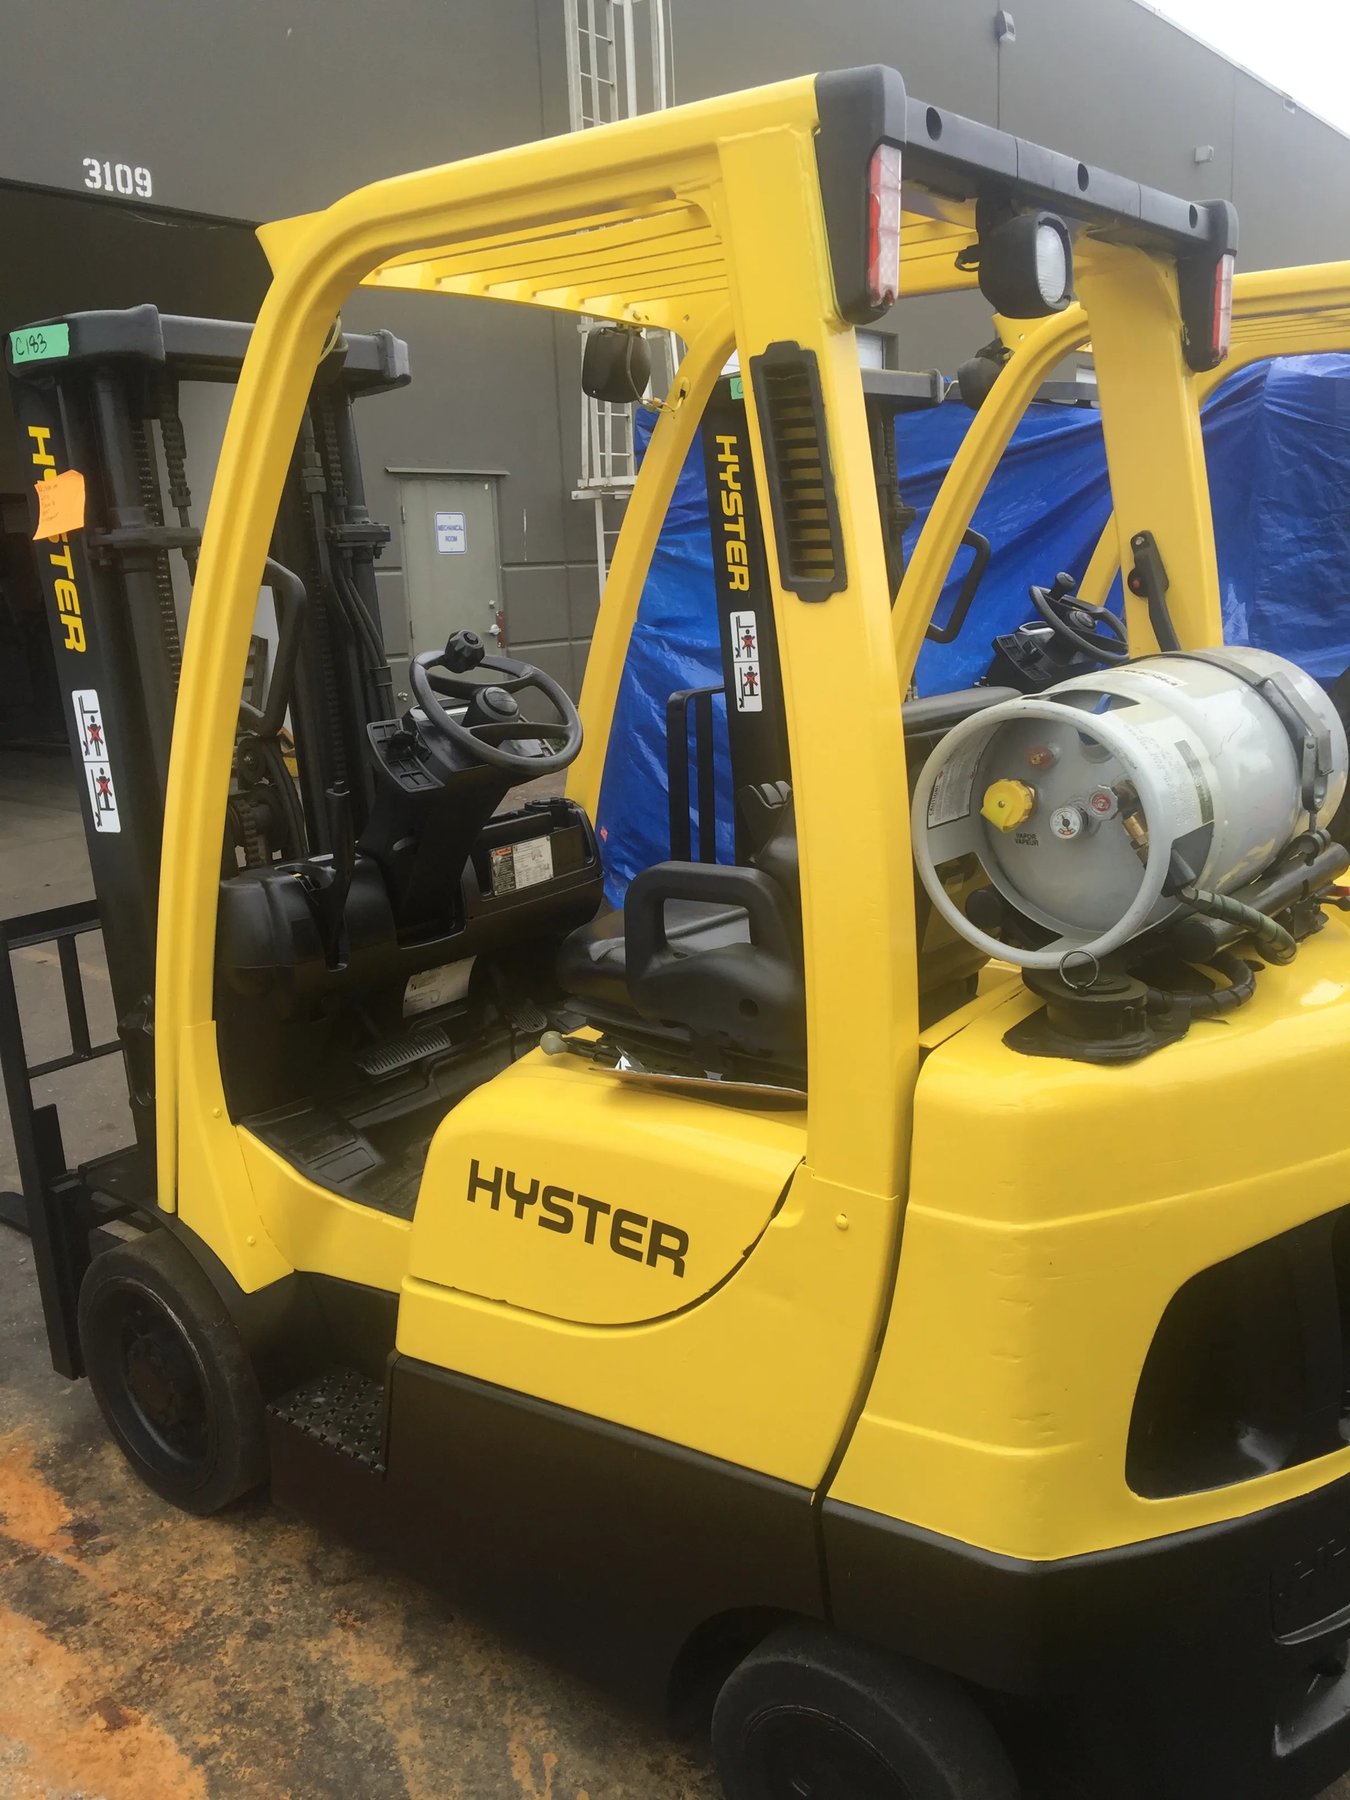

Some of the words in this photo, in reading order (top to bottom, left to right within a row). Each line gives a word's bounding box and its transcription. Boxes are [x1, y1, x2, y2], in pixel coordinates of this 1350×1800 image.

[82, 157, 153, 198] 3109
[15, 332, 48, 356] C183
[715, 435, 750, 592] HYSTER
[27, 425, 87, 653] HTER
[445, 535, 458, 543] ROOM
[1015, 832, 1037, 841] VAPOR
[466, 1158, 690, 1278] HYSTER
